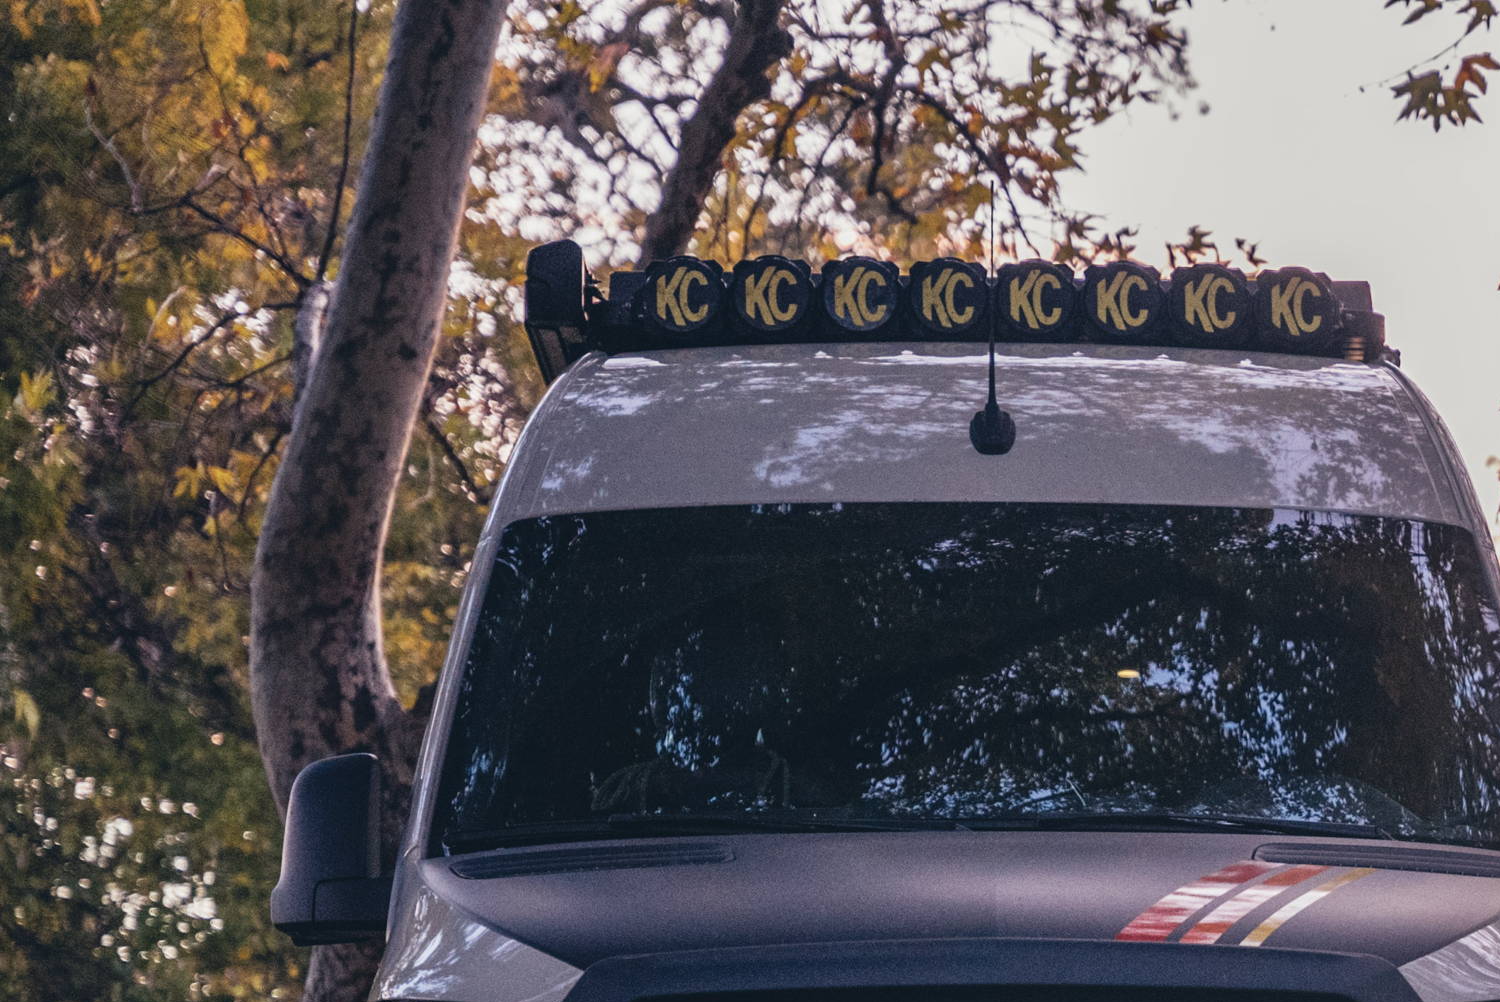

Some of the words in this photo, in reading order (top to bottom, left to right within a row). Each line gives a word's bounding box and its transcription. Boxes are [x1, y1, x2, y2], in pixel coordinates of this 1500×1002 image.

[656, 266, 709, 327] KC
[745, 266, 798, 326] KC
[834, 266, 887, 327] KC
[922, 268, 975, 328] KC
[1009, 269, 1062, 330] KC
[1097, 271, 1149, 331] KC
[1184, 273, 1237, 333] KC
[1271, 276, 1323, 337] KC
